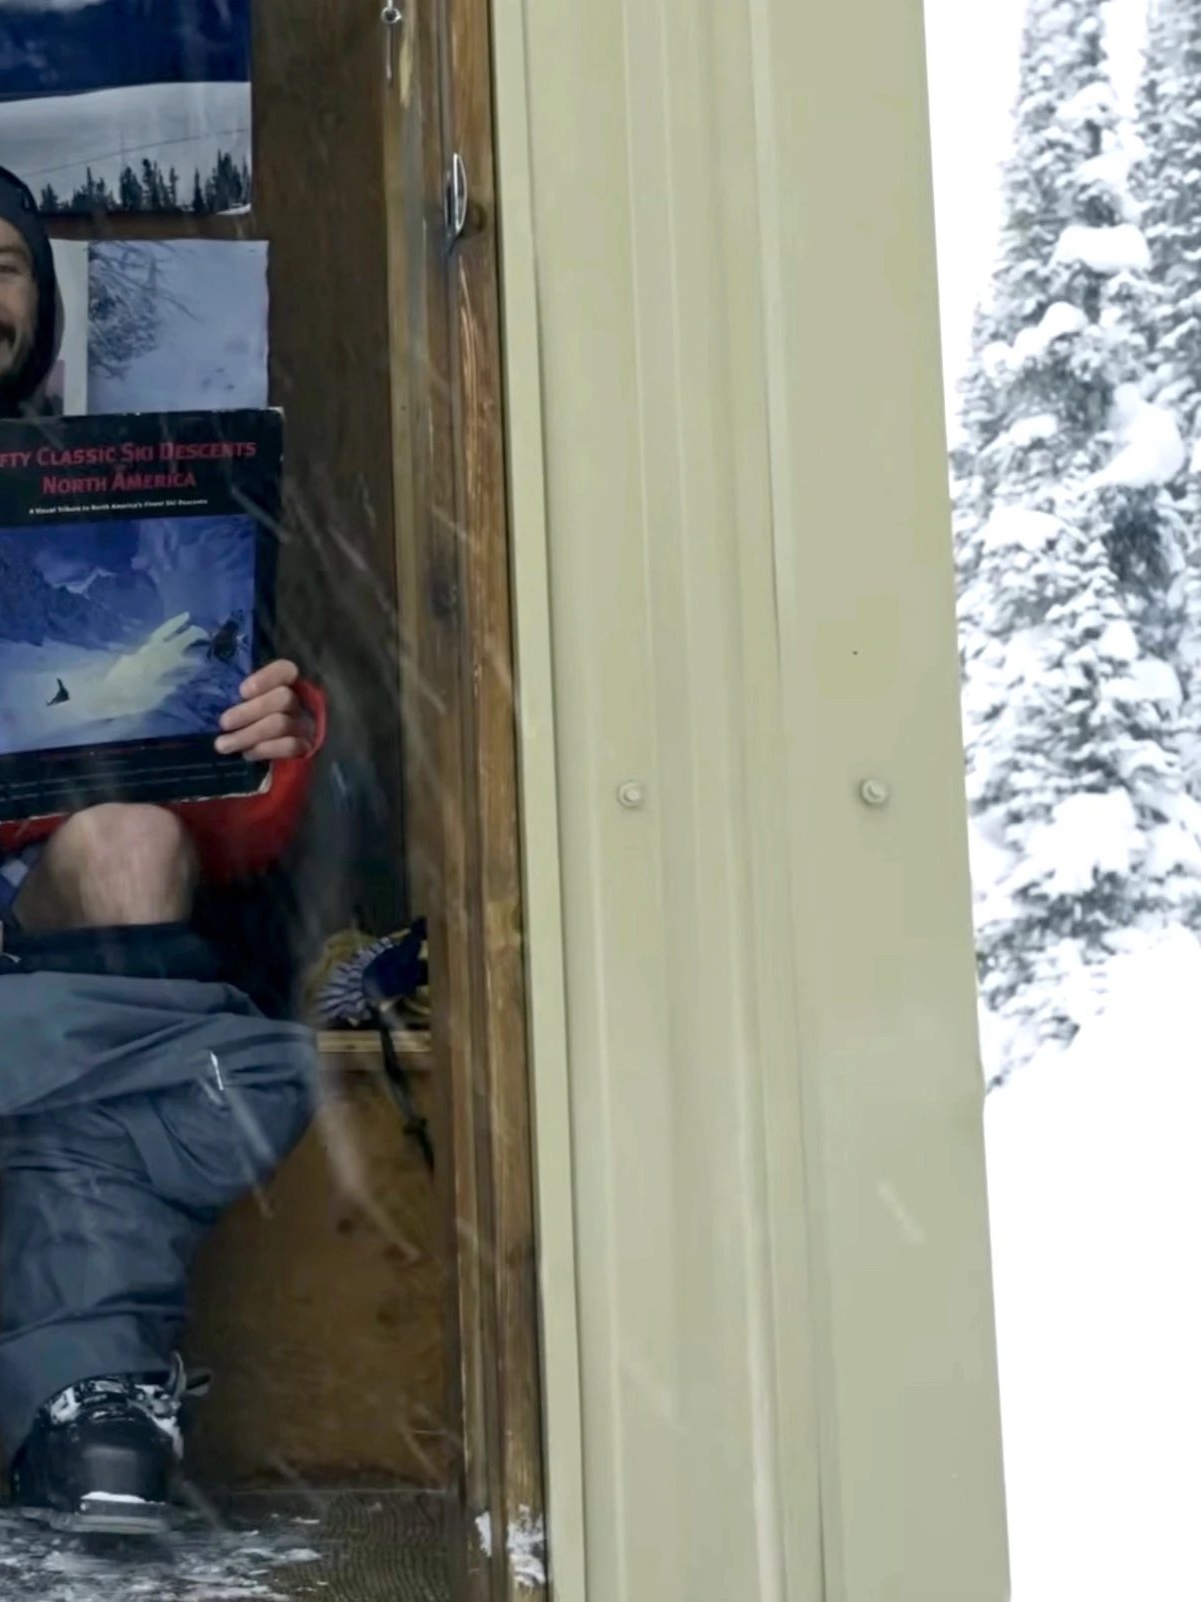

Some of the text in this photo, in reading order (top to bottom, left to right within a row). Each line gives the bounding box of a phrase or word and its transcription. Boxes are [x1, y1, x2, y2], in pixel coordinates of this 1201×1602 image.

[36, 446, 116, 467] CLASSIC
[122, 442, 153, 462] SKI
[159, 441, 256, 460] DESCENTS
[41, 471, 197, 494] NORTH AMERICA
